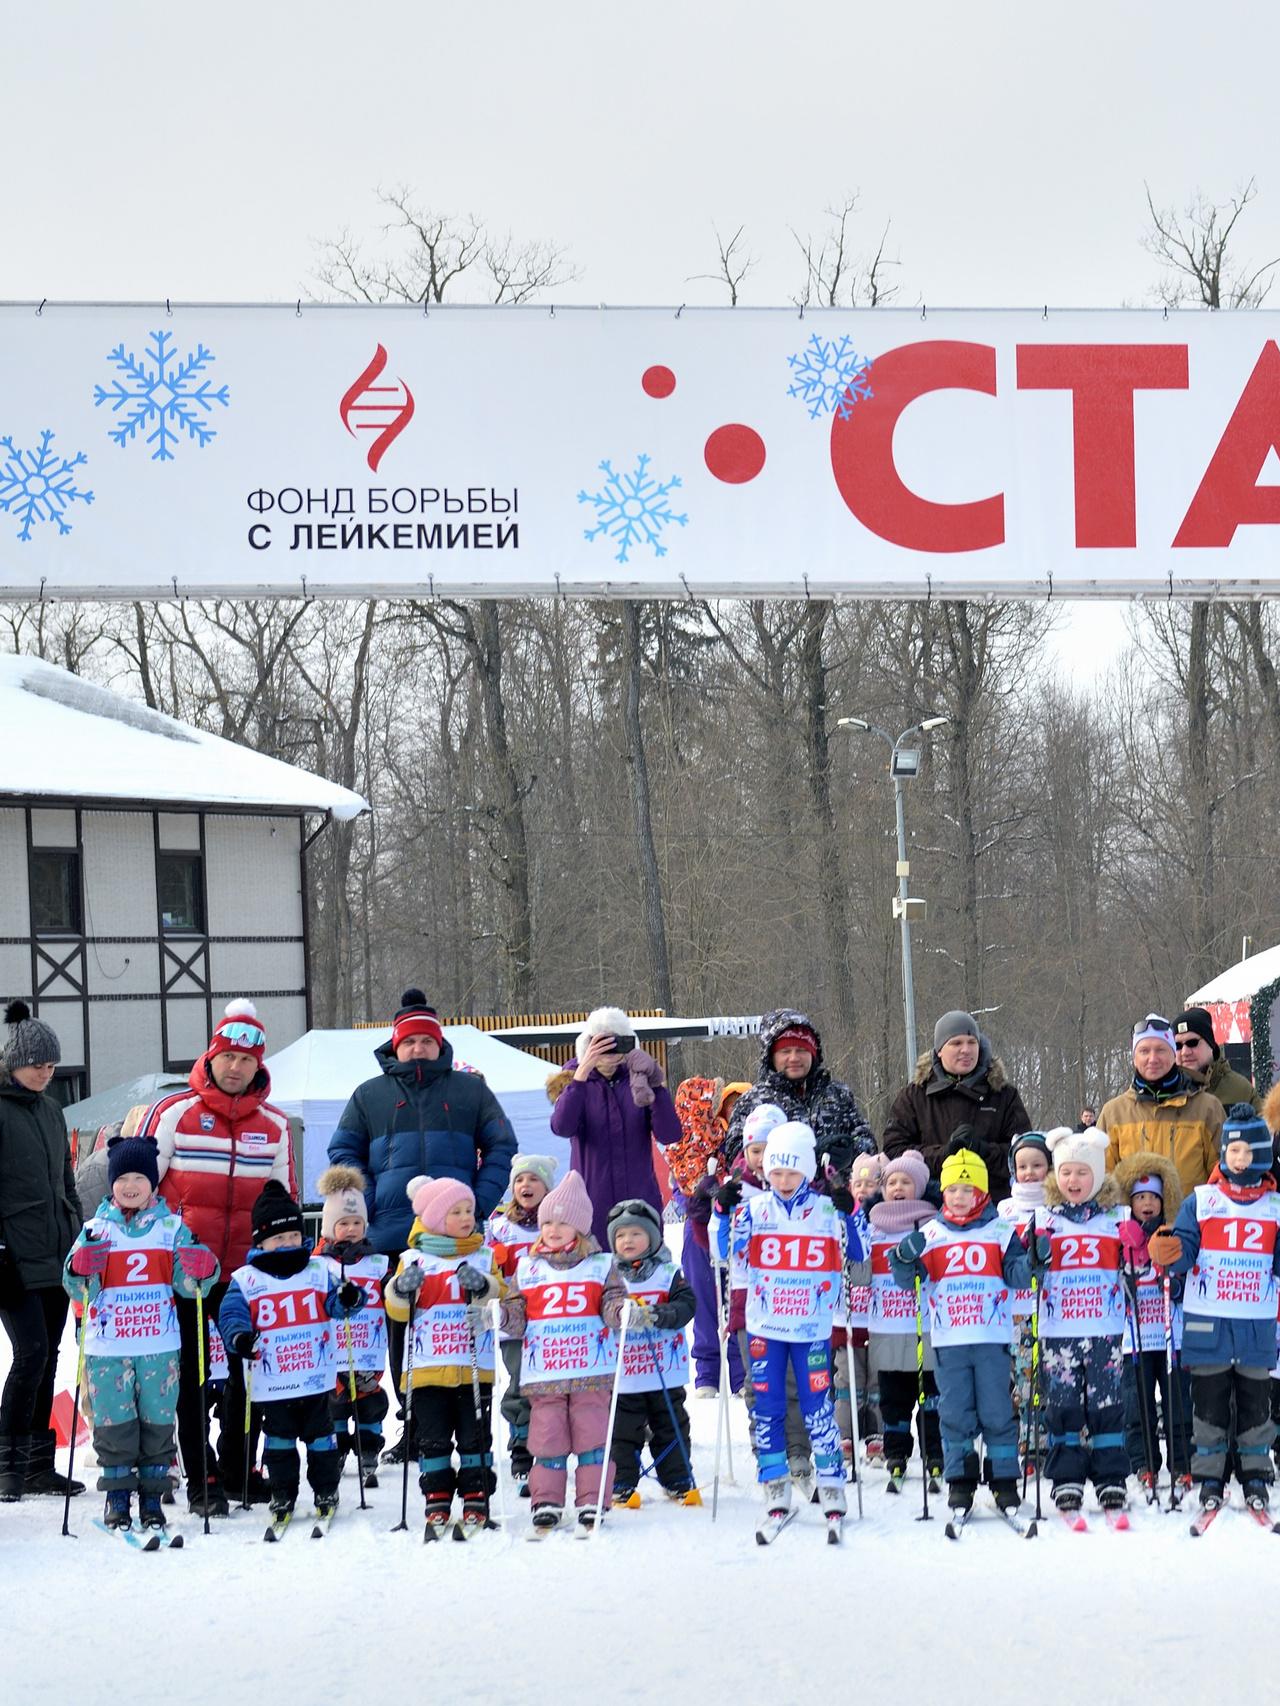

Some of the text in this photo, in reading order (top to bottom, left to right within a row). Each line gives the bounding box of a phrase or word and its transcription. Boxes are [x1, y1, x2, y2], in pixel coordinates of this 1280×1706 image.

[247, 487, 518, 519] ФОНД БОРЬБЫ
[248, 516, 519, 550] С ЛЕЙКЕМИЕЙ
[1223, 1220, 1264, 1250] 12
[760, 1237, 826, 1268] 815
[1061, 1238, 1101, 1267] 23
[946, 1244, 987, 1274] 20
[1219, 1257, 1263, 1268] ЛЫЖНЯ
[127, 1252, 149, 1282] 2
[774, 1277, 812, 1285] ЛЫЖНЯ
[1062, 1275, 1101, 1285] ЛЫЖНЯ
[1218, 1269, 1261, 1281] САМОЕ
[1217, 1279, 1260, 1291] ВРЕМЯ
[115, 1291, 161, 1302] ЛЫЖНЯ
[773, 1287, 810, 1297] САМОЕ
[1062, 1286, 1101, 1297] САМОЕ
[1216, 1291, 1260, 1303] ЖИТЬ
[542, 1285, 588, 1315] 25
[773, 1297, 810, 1306] ВРЕМЯ
[1061, 1297, 1102, 1308] ВРЕМЯ
[115, 1303, 160, 1315] САМОЕ
[257, 1291, 320, 1328] 811
[773, 1306, 809, 1316] ЖИТЬ
[1062, 1307, 1102, 1319] ЖИТЬ
[114, 1314, 161, 1327] ВРЕМЯ
[115, 1326, 161, 1339] ЖИТЬ
[543, 1323, 587, 1334] ЛЫЖНЯ
[274, 1331, 312, 1343] ЛЫЖНЯ
[543, 1334, 588, 1347] САМОЕ
[275, 1341, 312, 1353] САМОЕ
[543, 1346, 588, 1359] ВРЕМЯ
[276, 1351, 313, 1363] ВРЕМЯ
[278, 1361, 315, 1373] ЖИТЬ
[544, 1358, 588, 1371] ЖИТЬ
